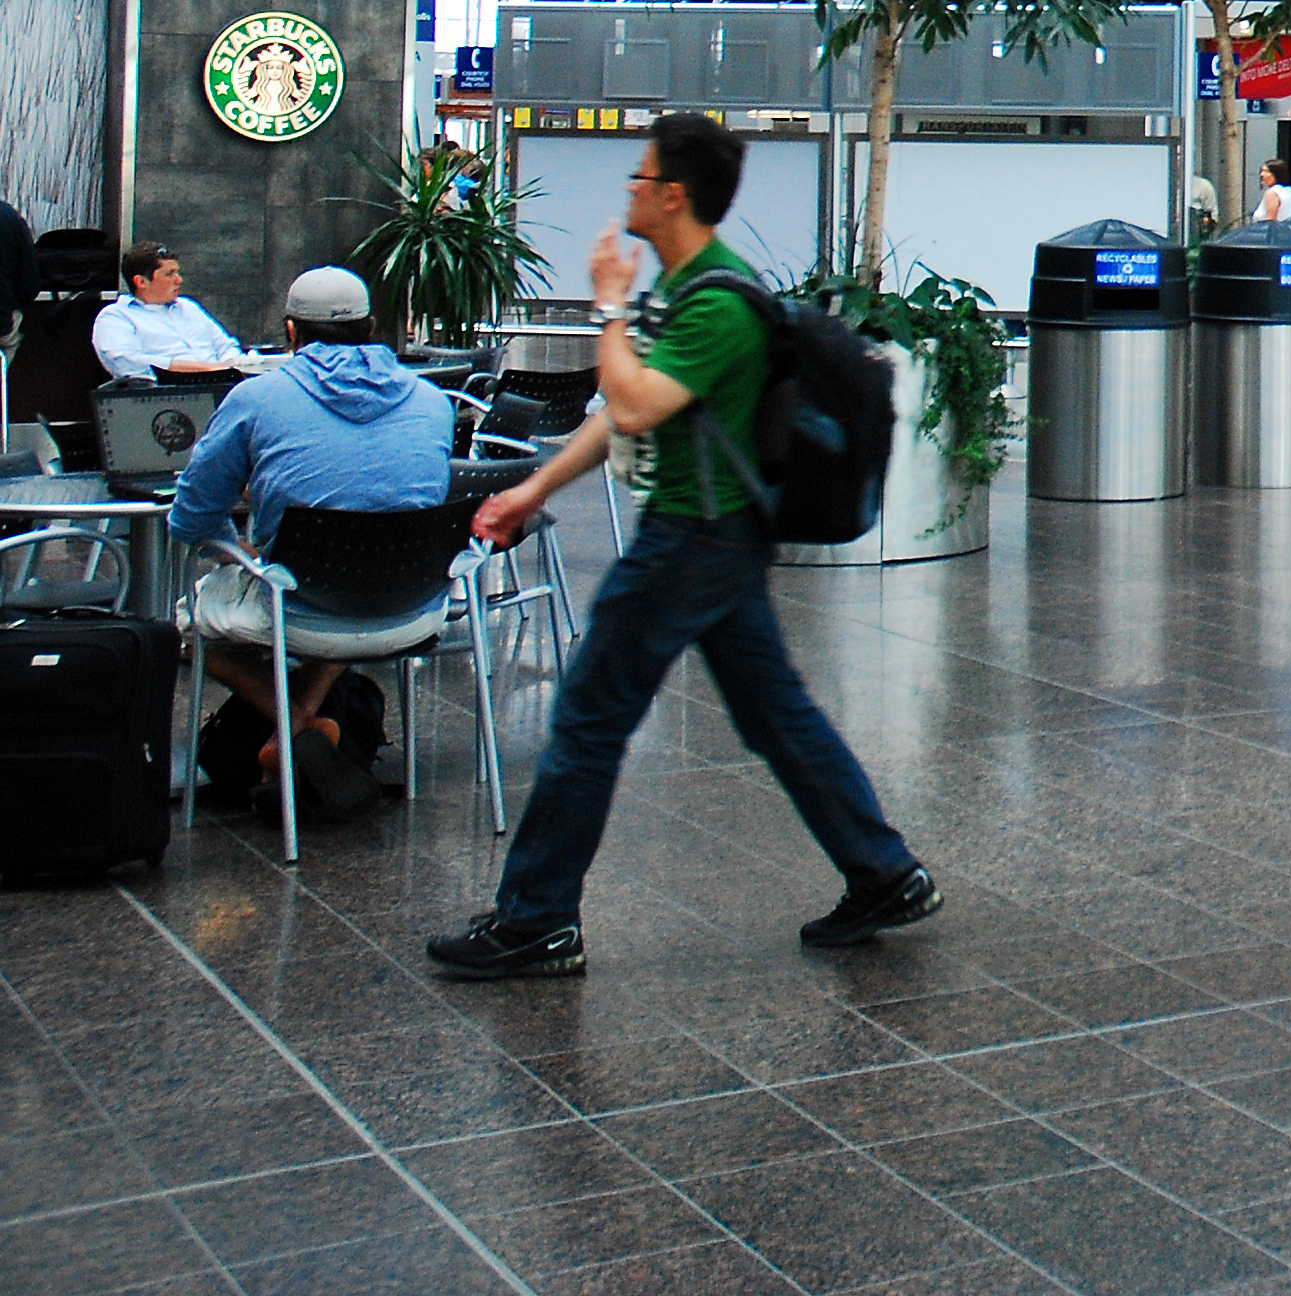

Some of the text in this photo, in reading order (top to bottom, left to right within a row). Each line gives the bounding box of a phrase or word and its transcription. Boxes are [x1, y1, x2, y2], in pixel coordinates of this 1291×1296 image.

[212, 18, 337, 75] STARBUCKS
[224, 100, 322, 134] COFFEE
[1096, 252, 1158, 264] RECYCLABLES
[1096, 274, 1123, 284] NEWS
[1129, 274, 1157, 285] PAPER
